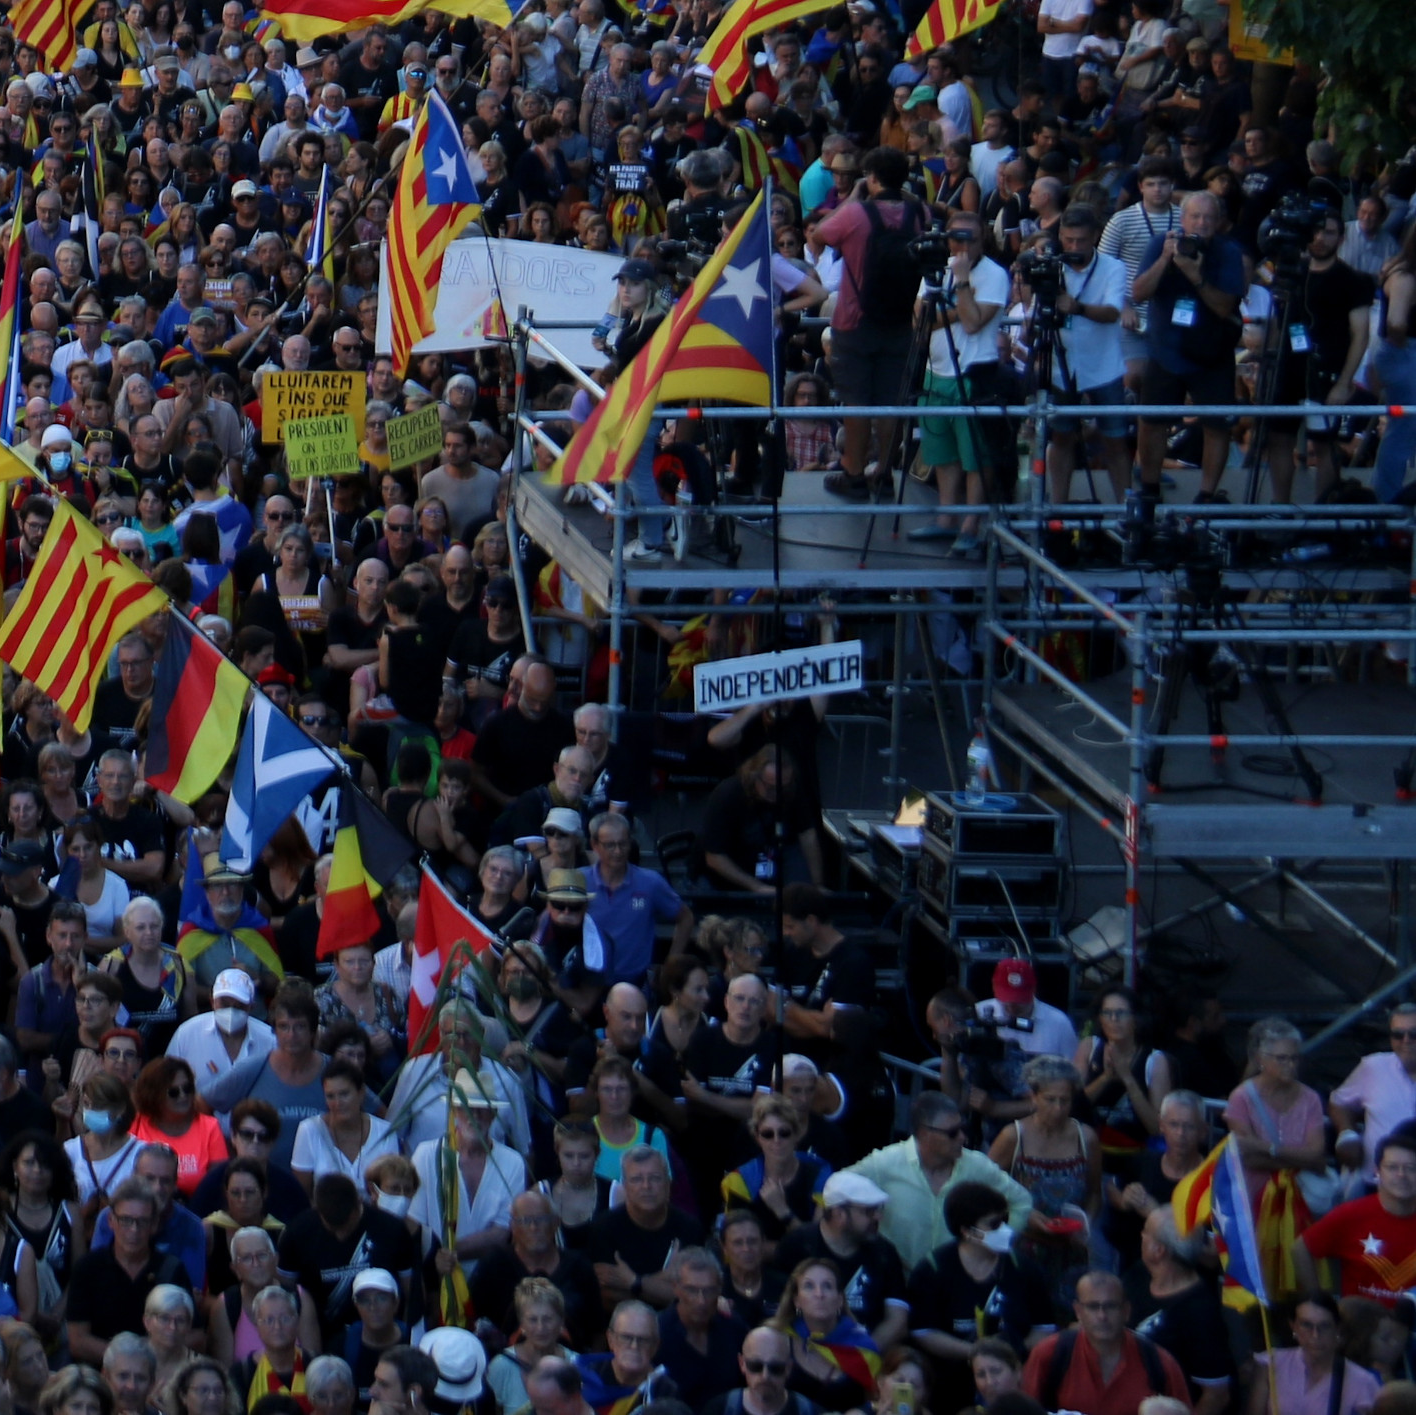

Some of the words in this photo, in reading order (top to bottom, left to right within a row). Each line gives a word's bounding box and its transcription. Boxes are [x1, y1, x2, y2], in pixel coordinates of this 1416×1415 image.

[269, 374, 353, 390] LLUITAREM
[277, 390, 315, 406] FINS
[322, 390, 350, 407] QUE
[289, 417, 350, 440] PRESIDENT
[388, 406, 441, 442] RECUPEREM
[390, 443, 409, 462] ELS
